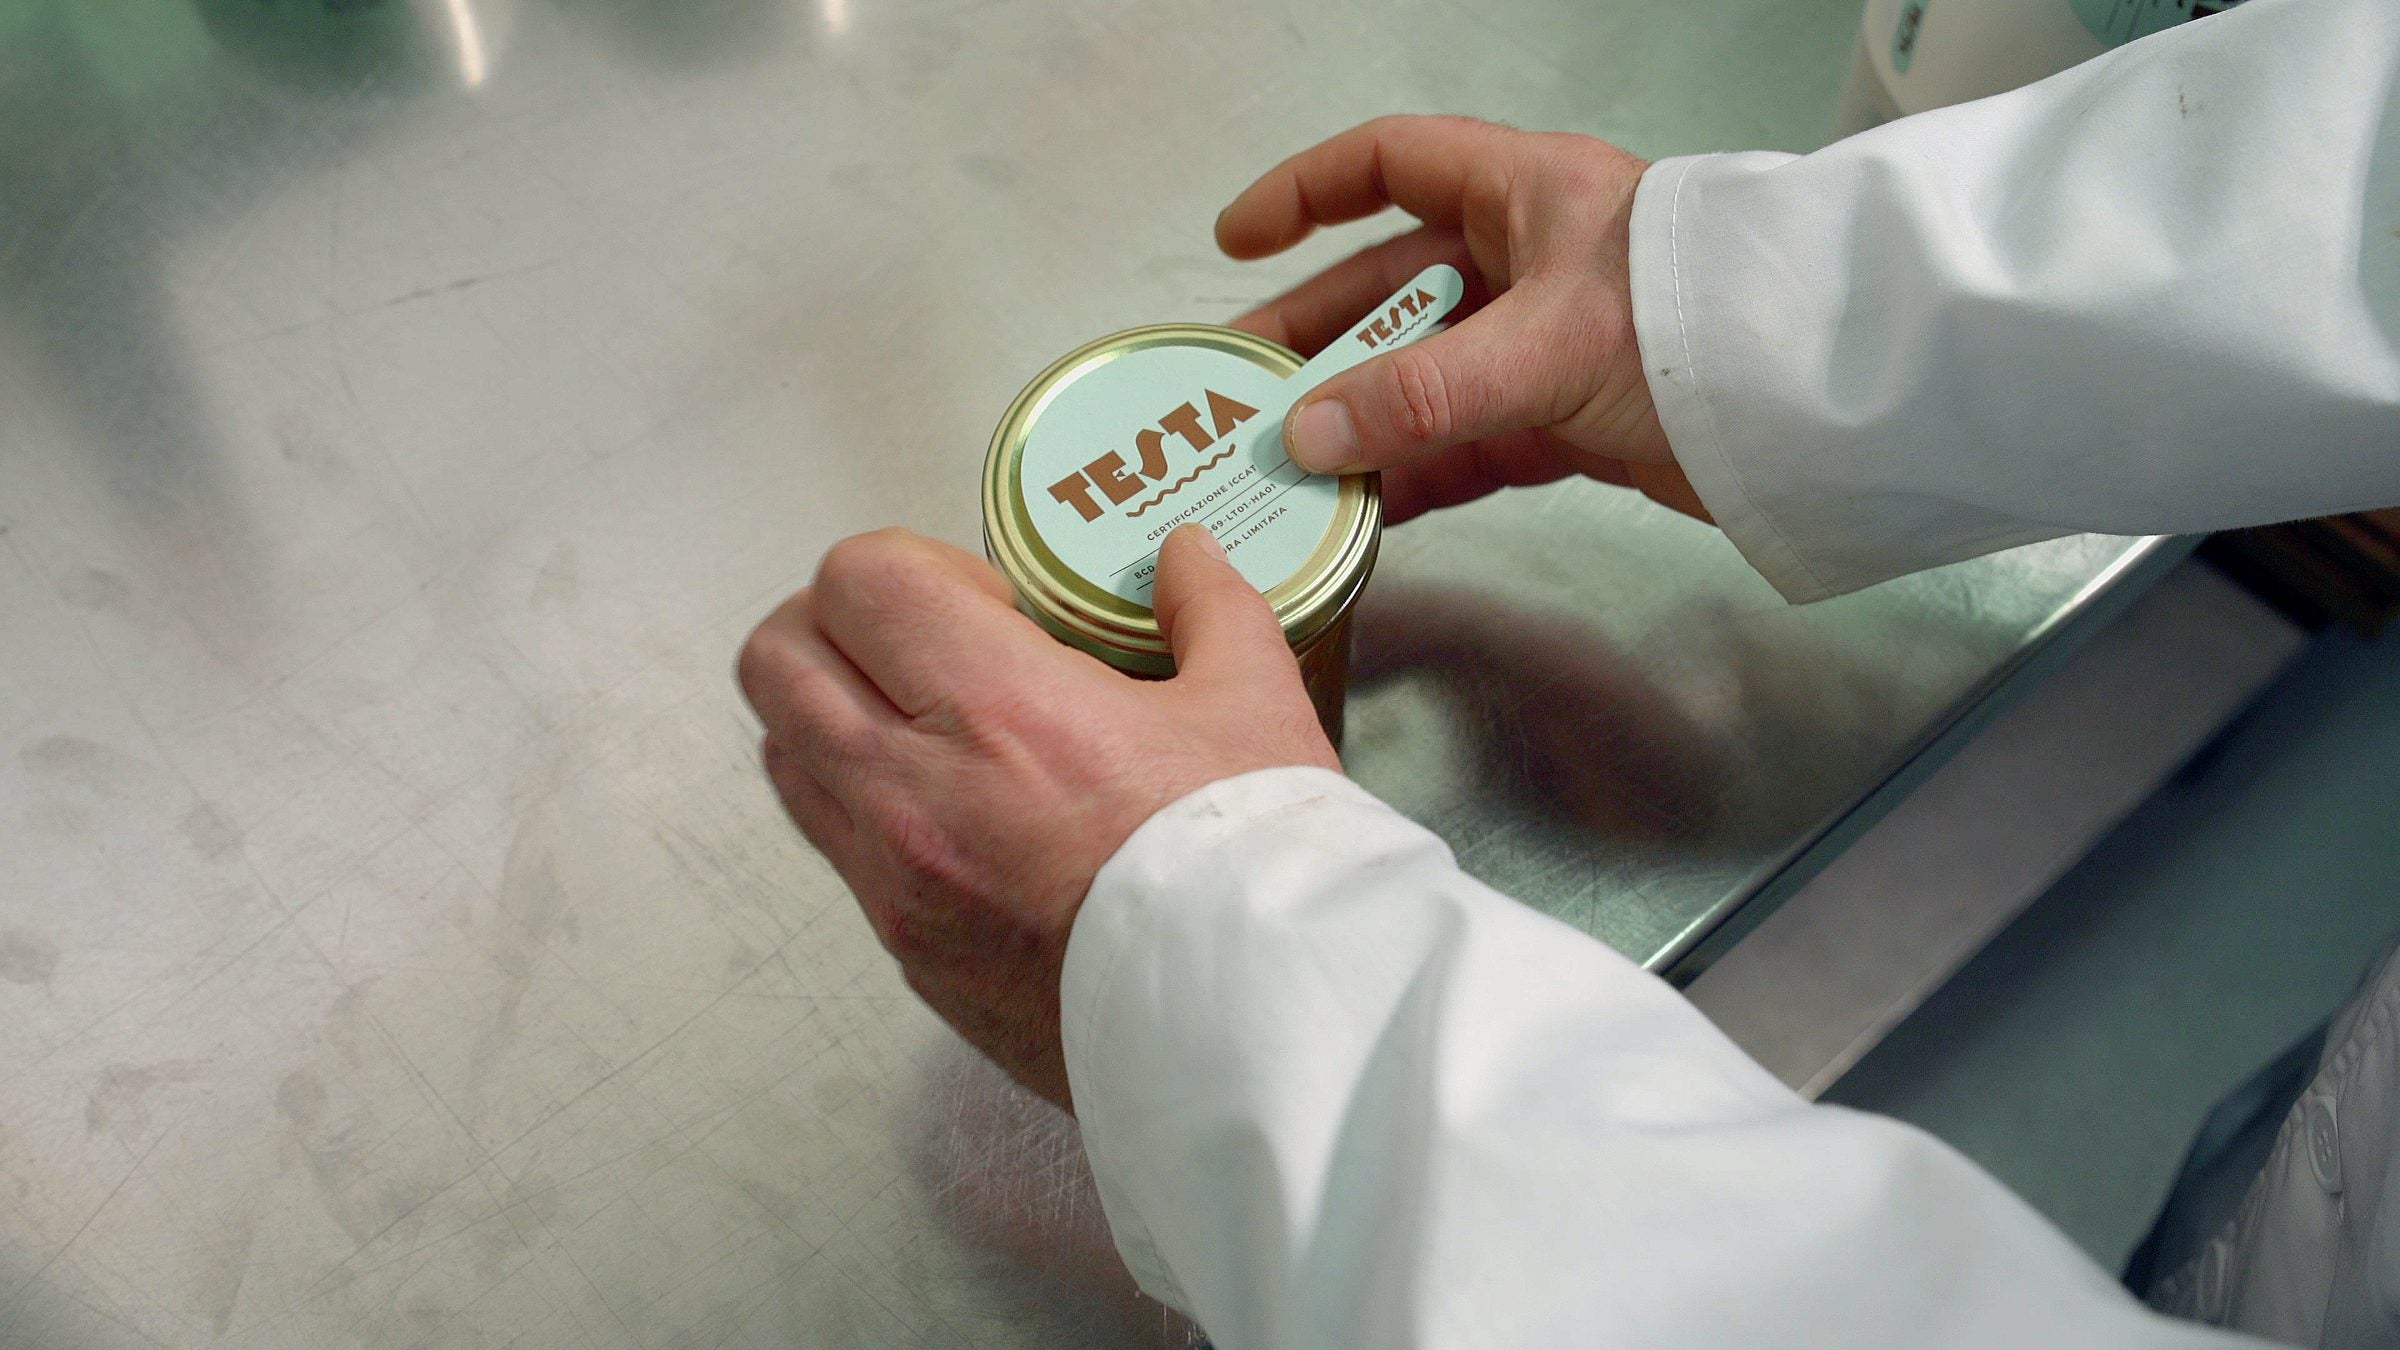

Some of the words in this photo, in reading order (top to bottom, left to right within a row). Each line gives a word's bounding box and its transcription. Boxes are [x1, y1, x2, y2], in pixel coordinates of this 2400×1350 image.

[1356, 288, 1437, 349] TESTA
[1047, 388, 1260, 523] TESTA
[1147, 485, 1228, 541] CERTIFICAZIONE
[1228, 464, 1257, 487] ICCAT
[1209, 483, 1277, 534] 69-LT01-HA01
[1241, 507, 1287, 540] LIMITATA
